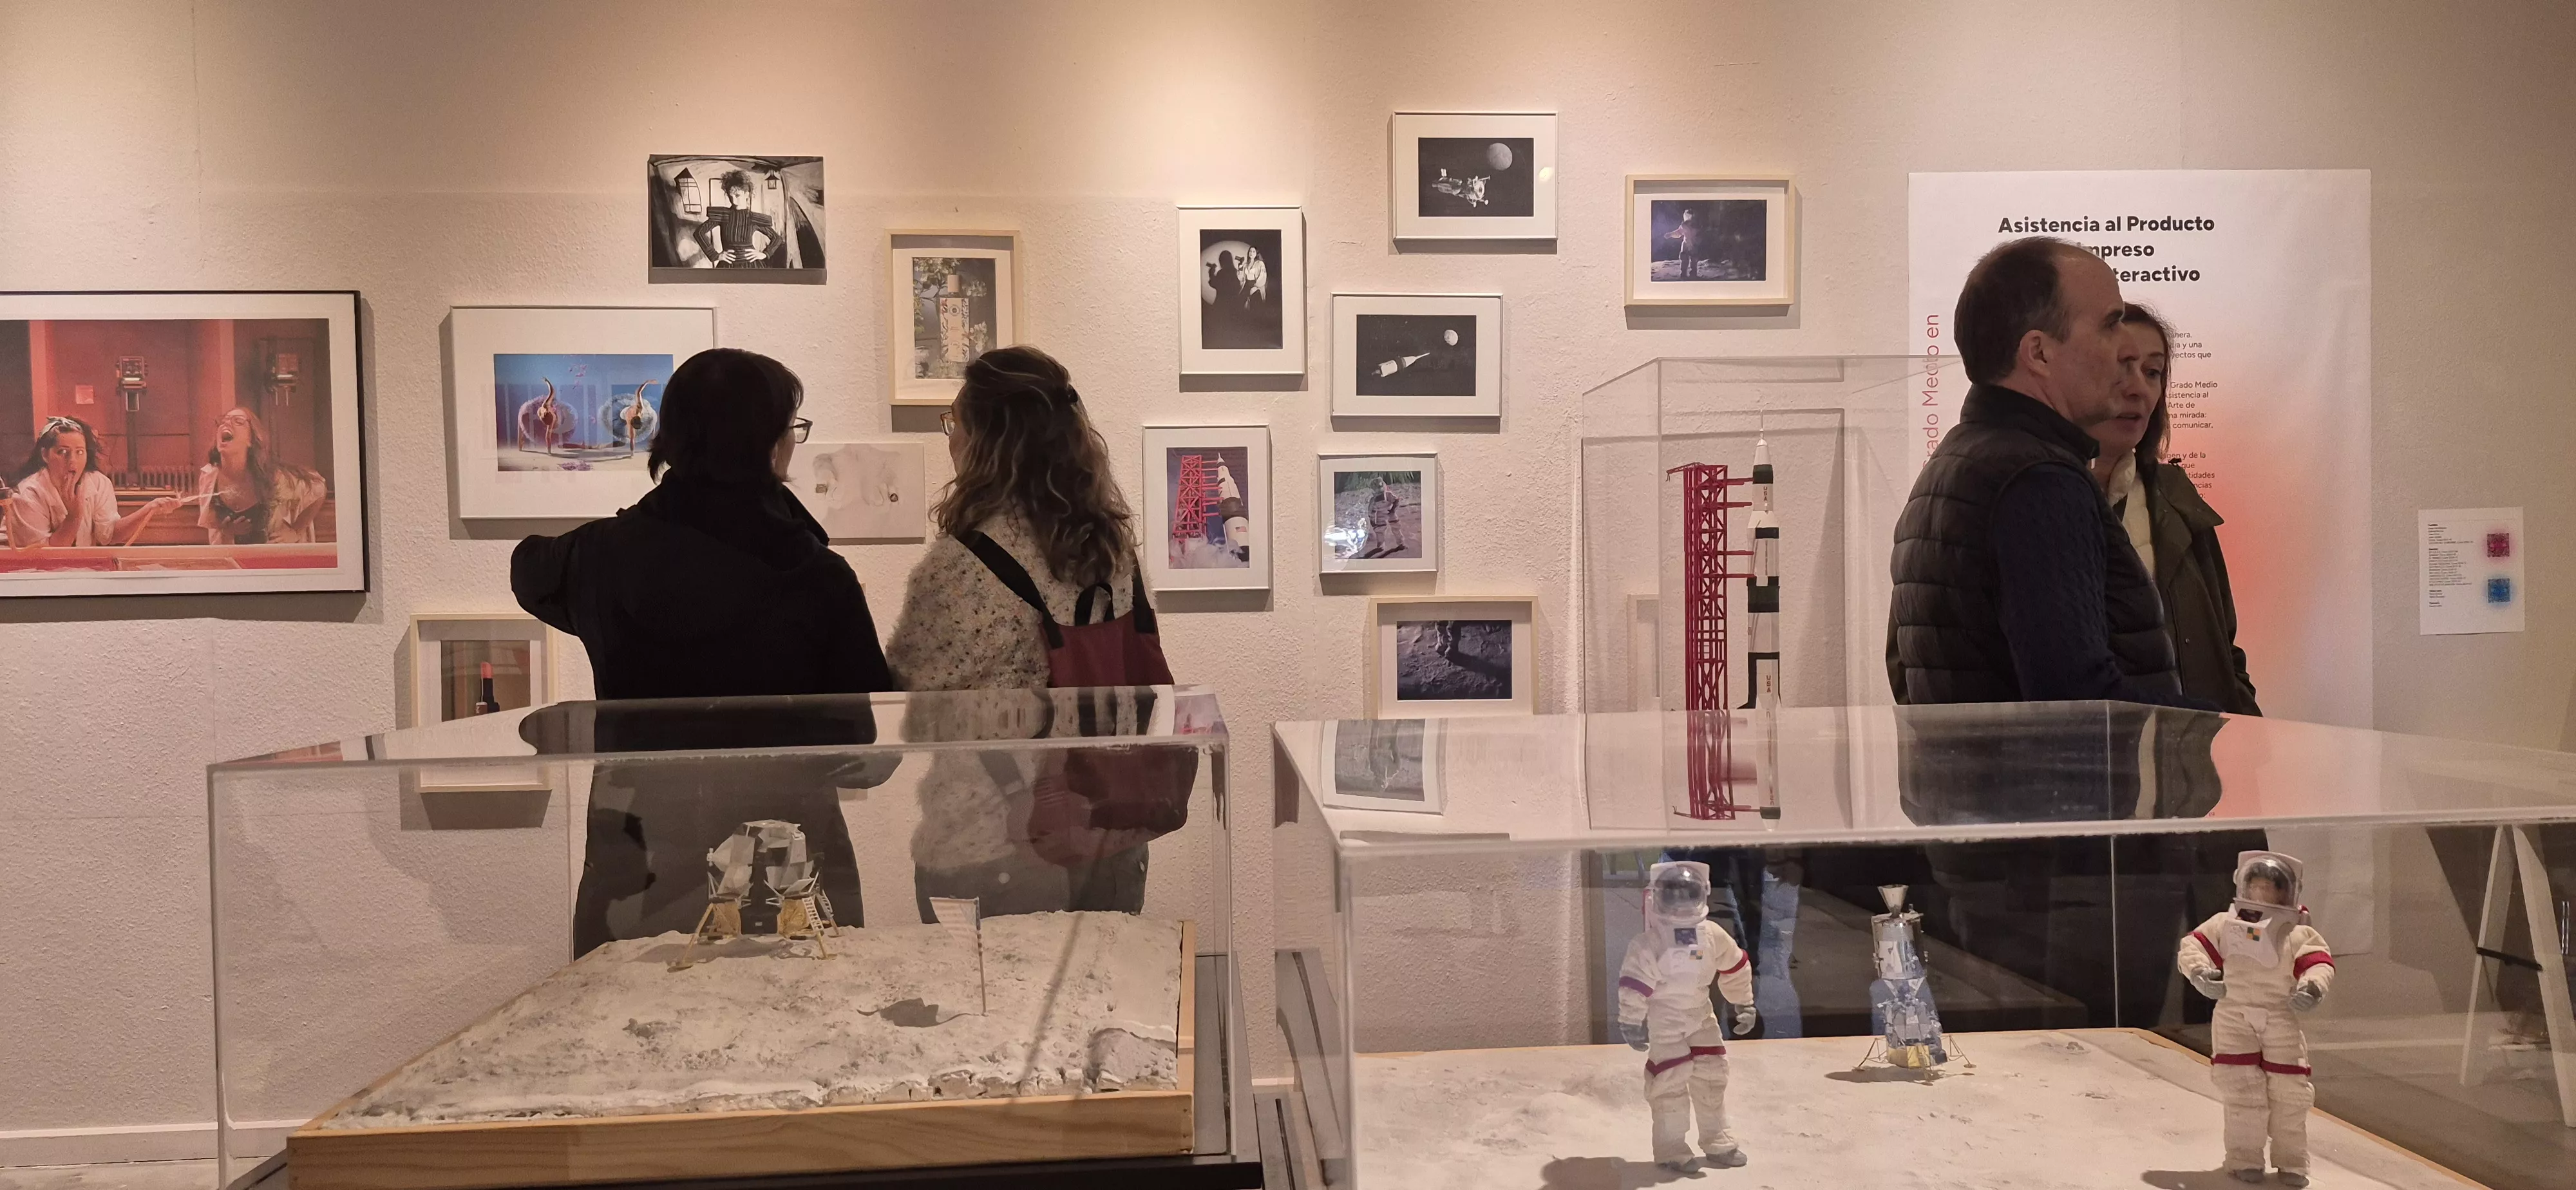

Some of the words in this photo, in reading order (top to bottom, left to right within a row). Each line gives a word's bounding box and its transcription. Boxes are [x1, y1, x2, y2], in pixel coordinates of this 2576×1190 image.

[1998, 216, 2100, 233] Asistencia
[2105, 216, 2121, 232] al
[2126, 215, 2215, 232] Producto
[1926, 314, 1939, 339] en
[2172, 421, 2213, 430] comunicar,
